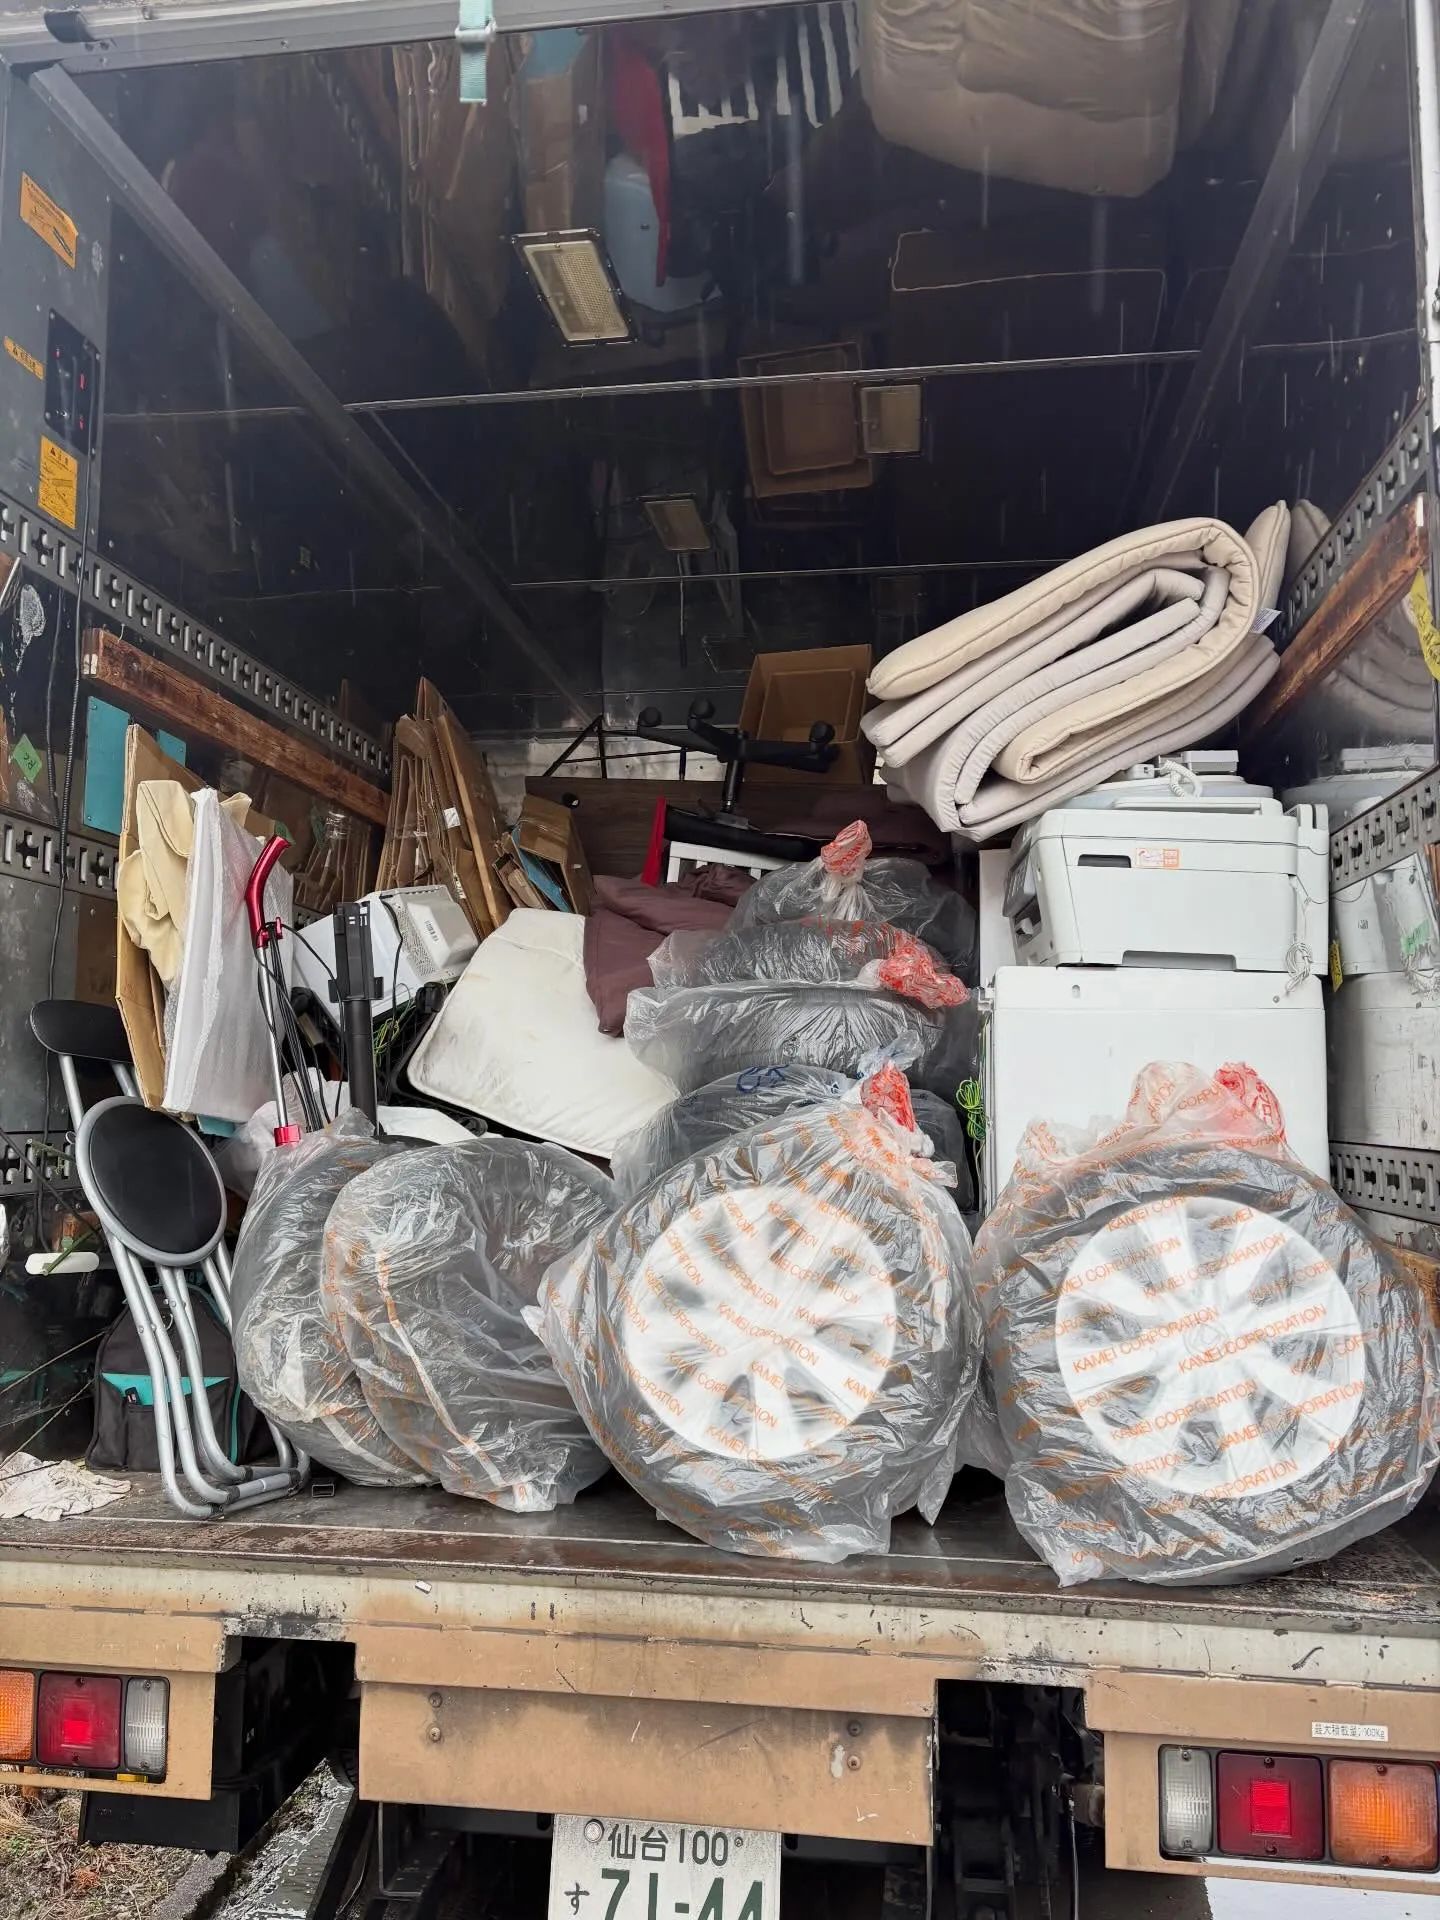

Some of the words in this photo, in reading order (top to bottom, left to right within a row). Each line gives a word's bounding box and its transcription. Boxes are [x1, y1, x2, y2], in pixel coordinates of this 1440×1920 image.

[1073, 1347, 1117, 1374] KAMEI
[1119, 1305, 1221, 1355] CORPORATION
[1178, 1347, 1224, 1374] KAMEI
[1223, 1303, 1328, 1355] CORPORATION
[1154, 1378, 1259, 1431] CORPORATION
[607, 1823, 668, 1862] 仙台
[678, 1828, 729, 1867] 100
[564, 1882, 590, 1916] す
[600, 1867, 764, 1920] 71-44
